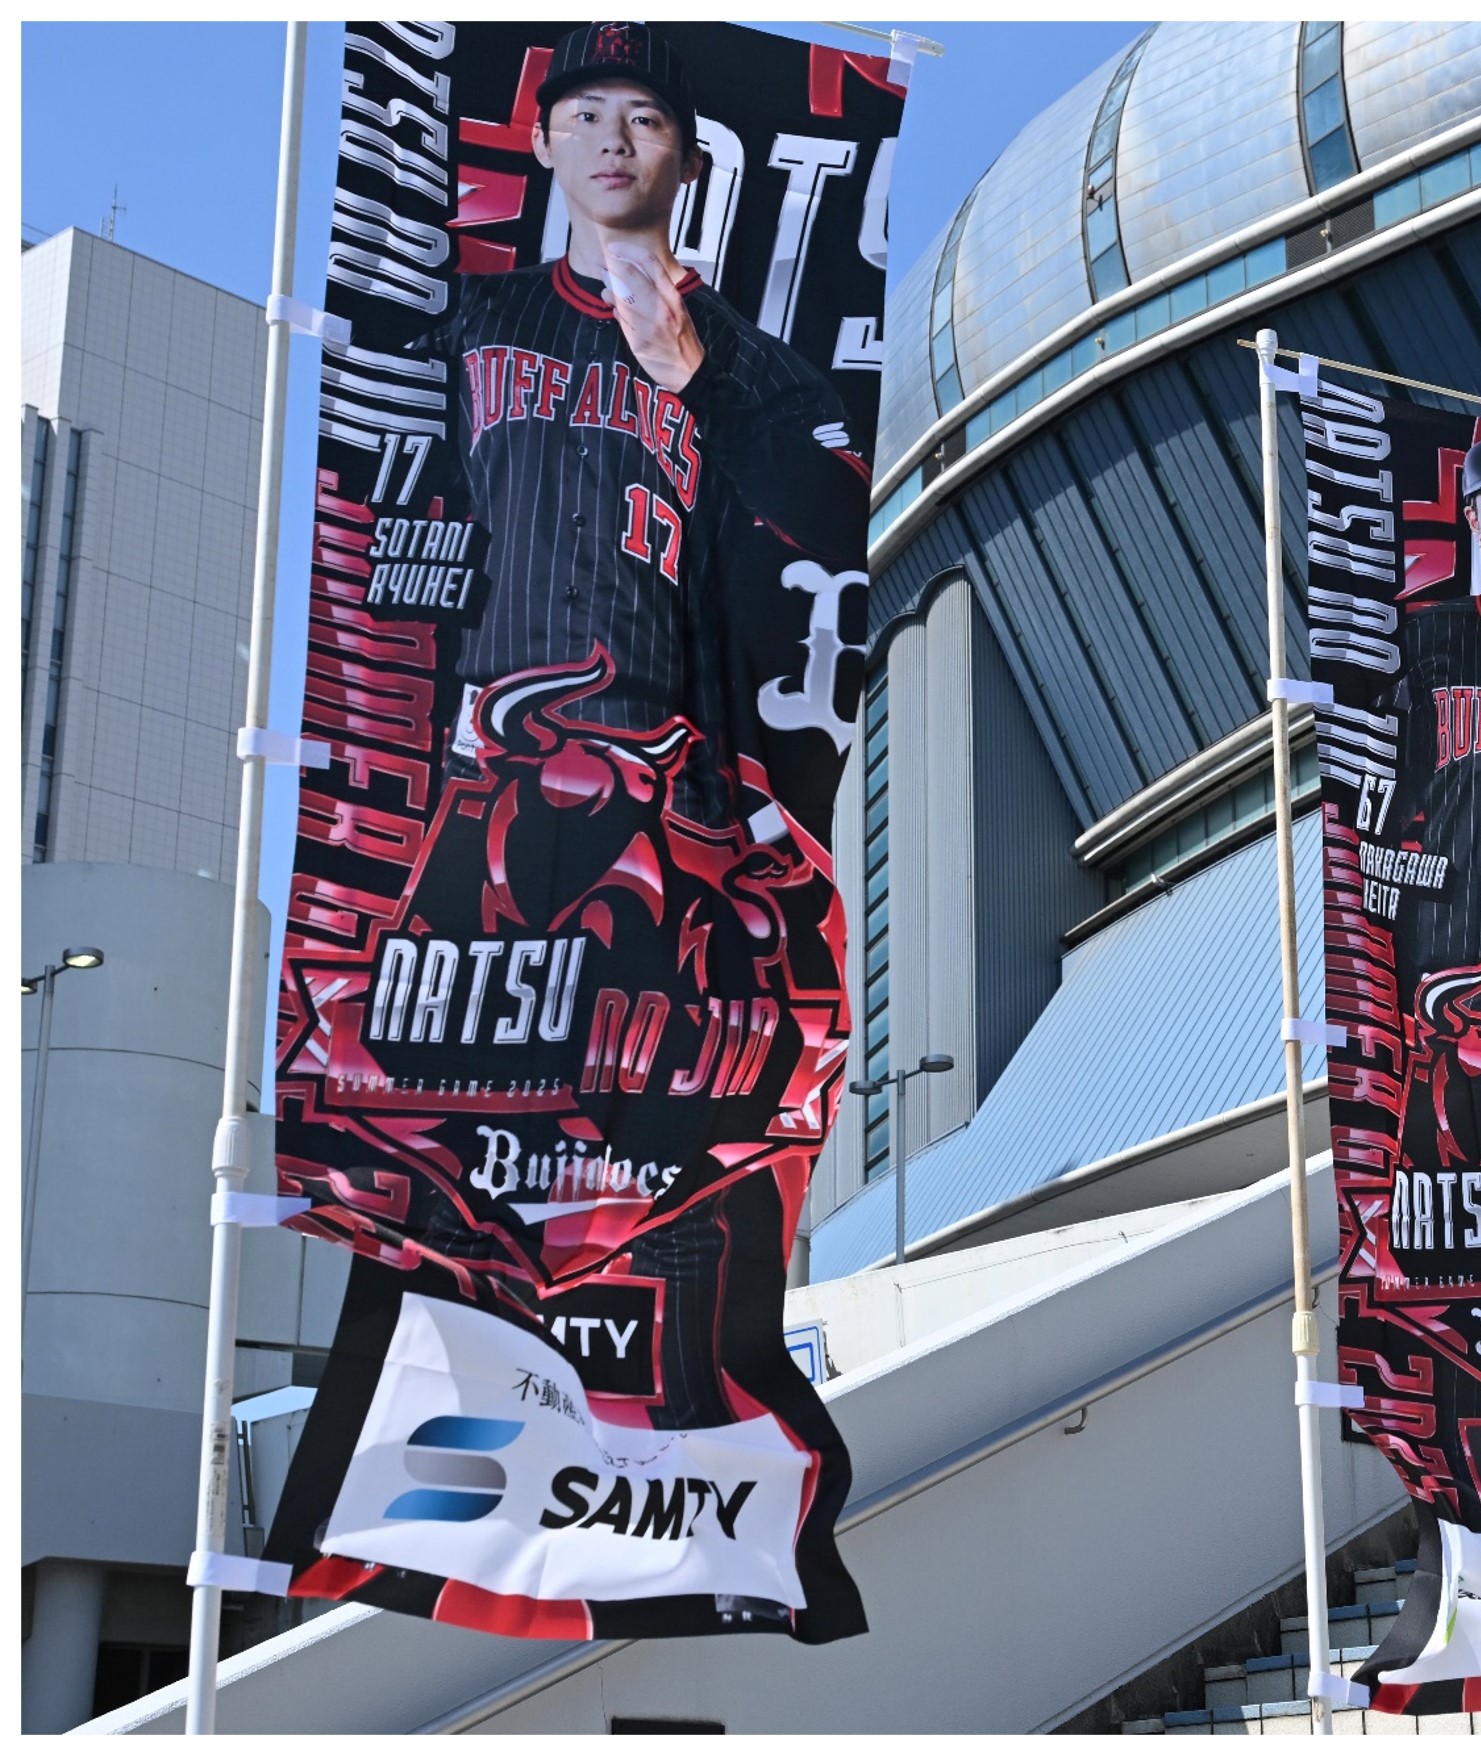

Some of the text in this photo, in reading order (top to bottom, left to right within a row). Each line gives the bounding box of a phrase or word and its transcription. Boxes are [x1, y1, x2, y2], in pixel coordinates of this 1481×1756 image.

[462, 343, 703, 508] BUFFALOES
[370, 433, 431, 506] 17
[369, 516, 474, 563] SOTANI
[621, 483, 681, 585] 17
[365, 563, 475, 611] RYUHEI
[1356, 773, 1397, 836] 67
[1359, 841, 1449, 890] NAKAGAWA
[368, 936, 588, 1045] NATSU
[580, 987, 780, 1099] NO JIN
[336, 1074, 561, 1098] SUMMER GAME 2025
[538, 1464, 758, 1542] SAMTY
